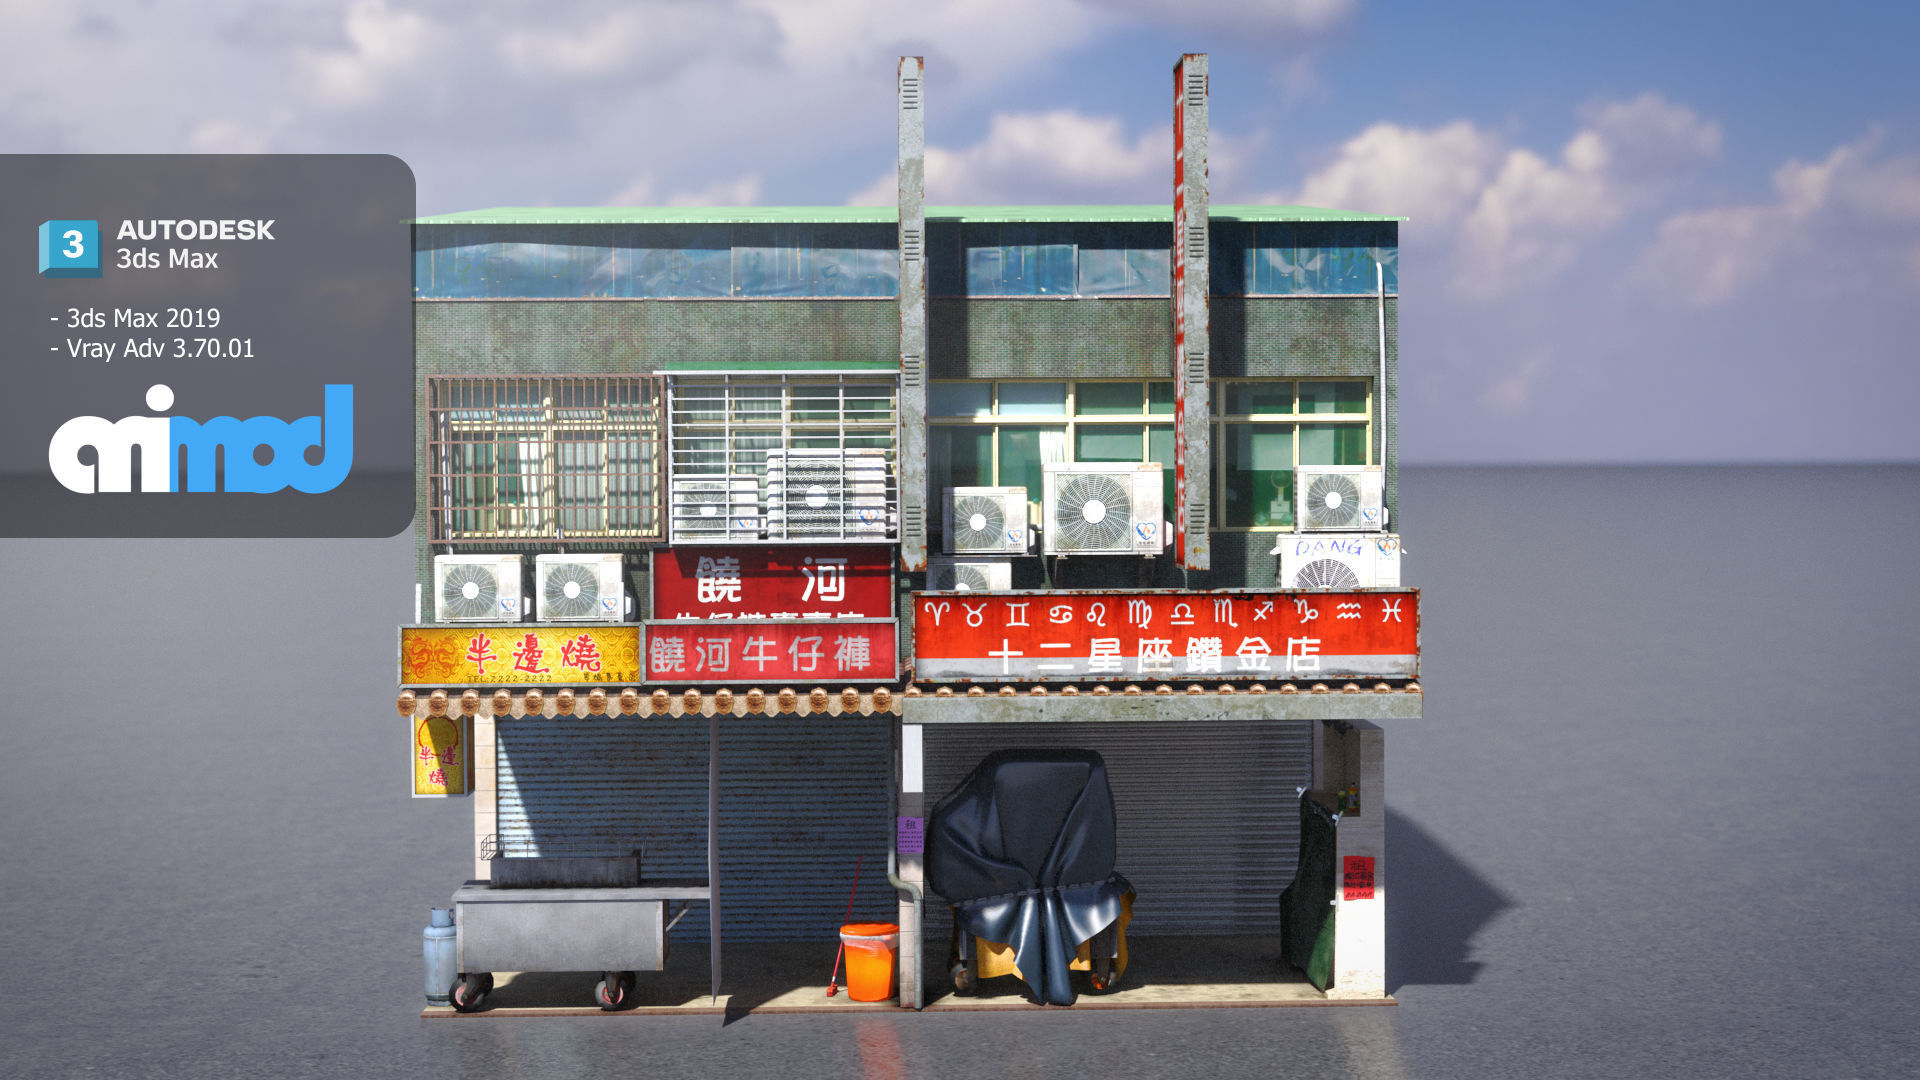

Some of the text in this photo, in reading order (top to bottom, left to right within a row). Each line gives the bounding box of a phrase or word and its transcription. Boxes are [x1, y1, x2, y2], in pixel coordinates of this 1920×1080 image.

[1296, 539, 1363, 556] DANG
[465, 632, 602, 675] 半邊燒
[649, 635, 872, 673] 饒河牛仔褲
[988, 636, 1322, 674] 十二星座鑽金店
